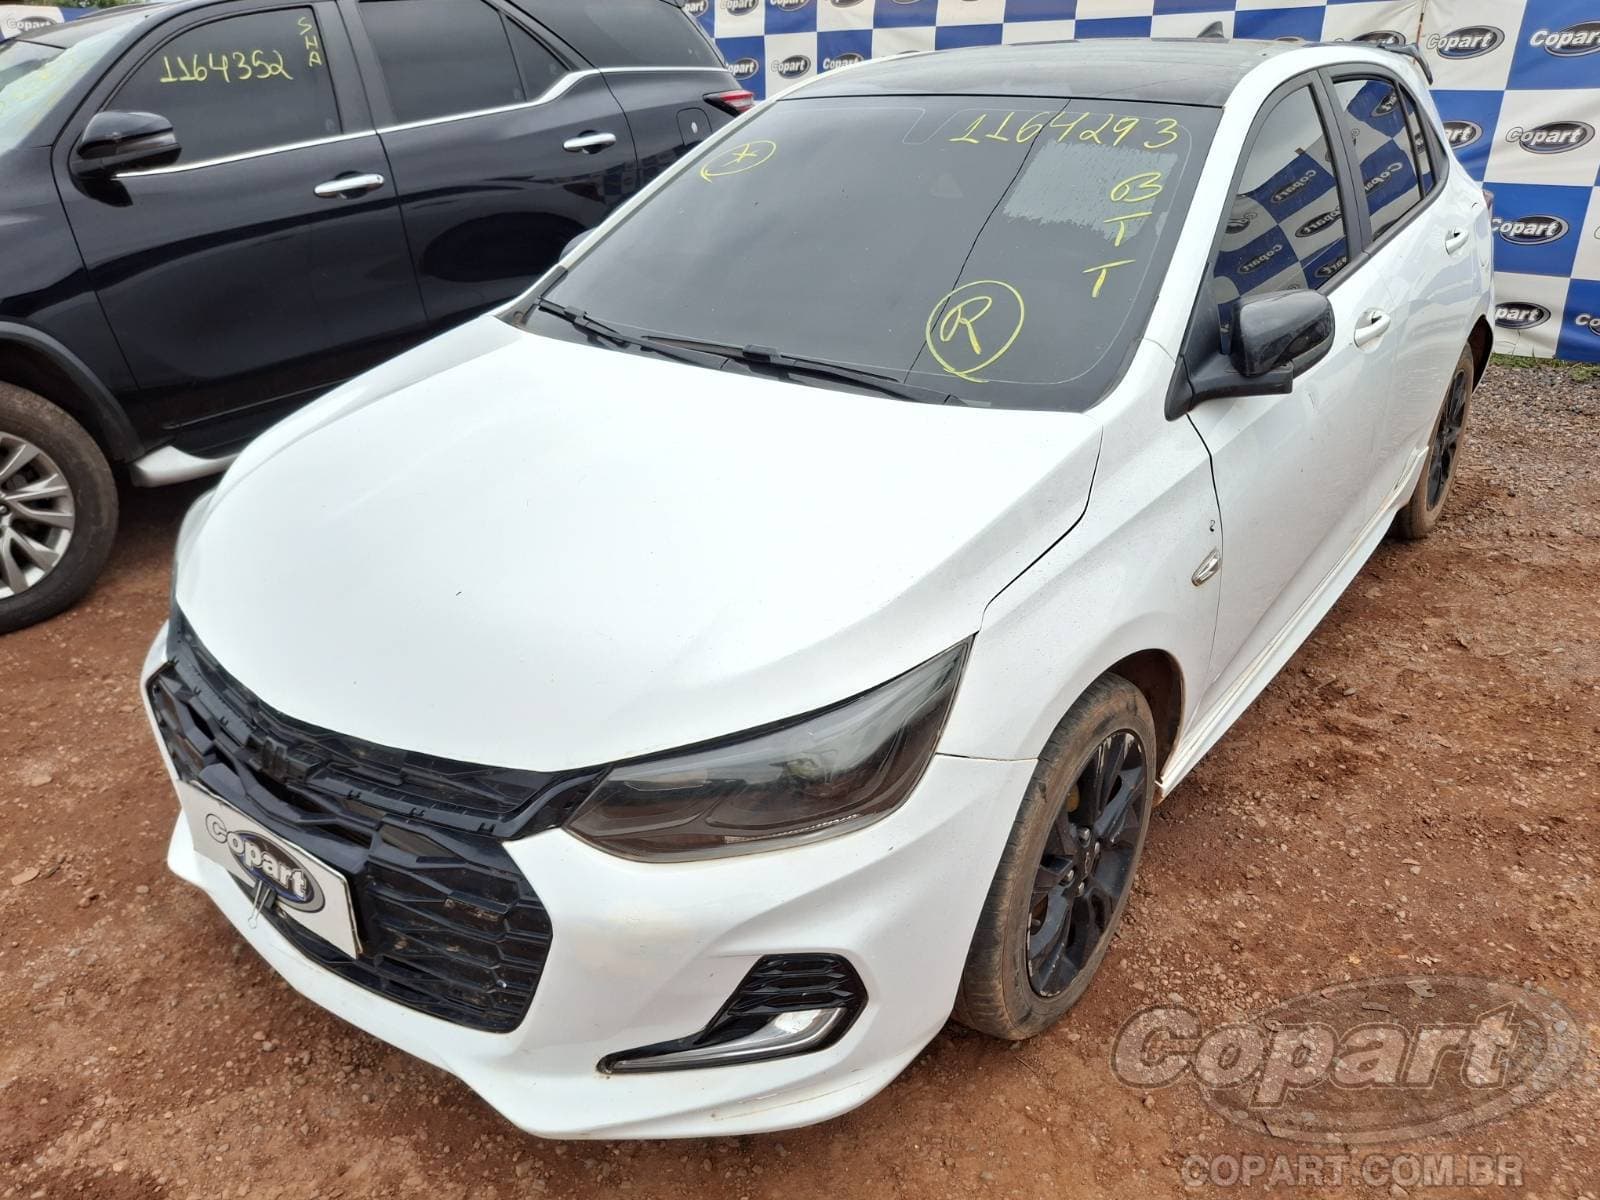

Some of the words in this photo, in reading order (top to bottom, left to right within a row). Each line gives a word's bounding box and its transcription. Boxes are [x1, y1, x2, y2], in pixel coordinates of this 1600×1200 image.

[1427, 30, 1491, 51] Copart
[1529, 29, 1600, 49] Copar
[160, 50, 293, 83] 1164352
[727, 62, 754, 75] opart
[771, 58, 805, 74] Copart
[949, 111, 1178, 148] 1164293
[1505, 124, 1580, 147] Copart
[205, 812, 309, 902] Copart
